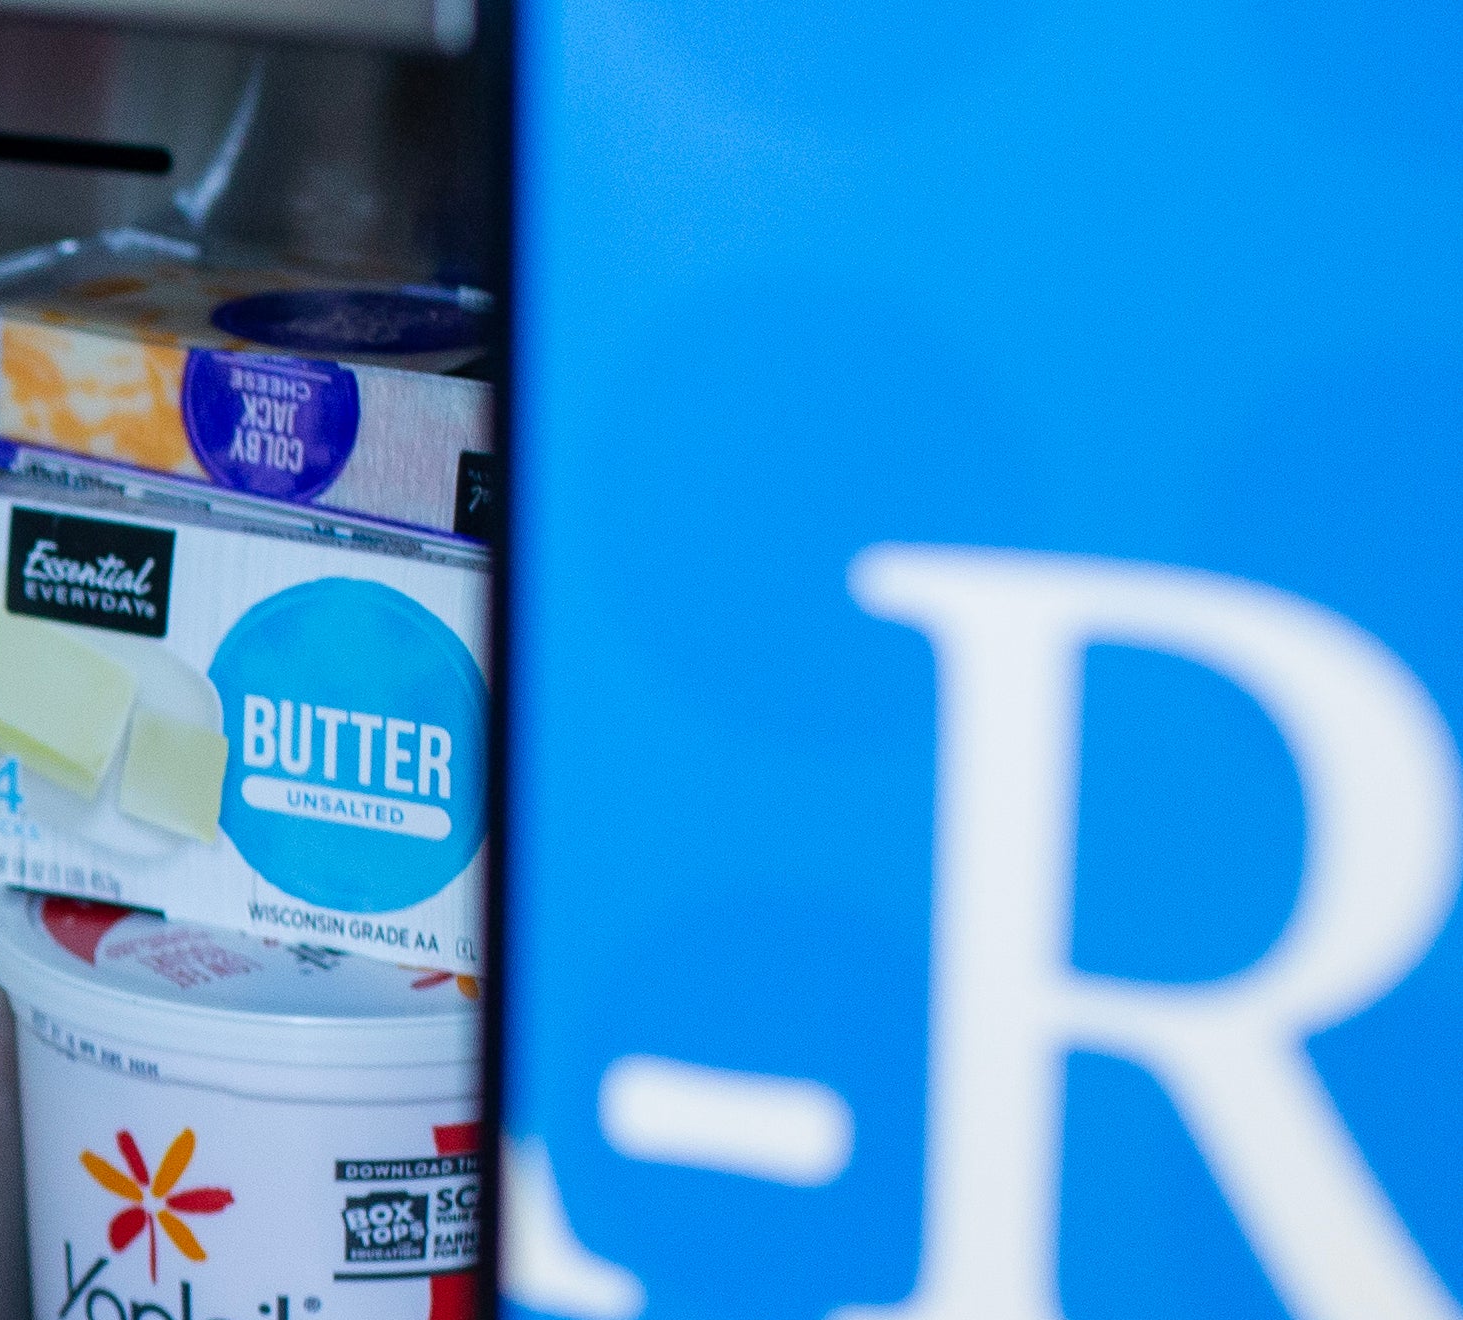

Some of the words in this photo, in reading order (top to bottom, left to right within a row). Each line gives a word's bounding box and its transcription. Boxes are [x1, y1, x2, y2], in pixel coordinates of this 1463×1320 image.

[231, 367, 311, 401] CHEESE
[240, 392, 299, 436] JACK
[230, 426, 304, 475] COLBY
[22, 539, 155, 595] Essential
[243, 694, 453, 799] BUTTER
[286, 790, 405, 825] UNSALTED
[248, 902, 345, 937] WISCONSIN
[349, 919, 410, 948] GRADE
[414, 931, 440, 954] AA
[344, 1158, 454, 1180] DOWNLOAD
[344, 1200, 414, 1232] BOX
[436, 1185, 479, 1212] SC
[355, 1221, 426, 1248] TOPS
